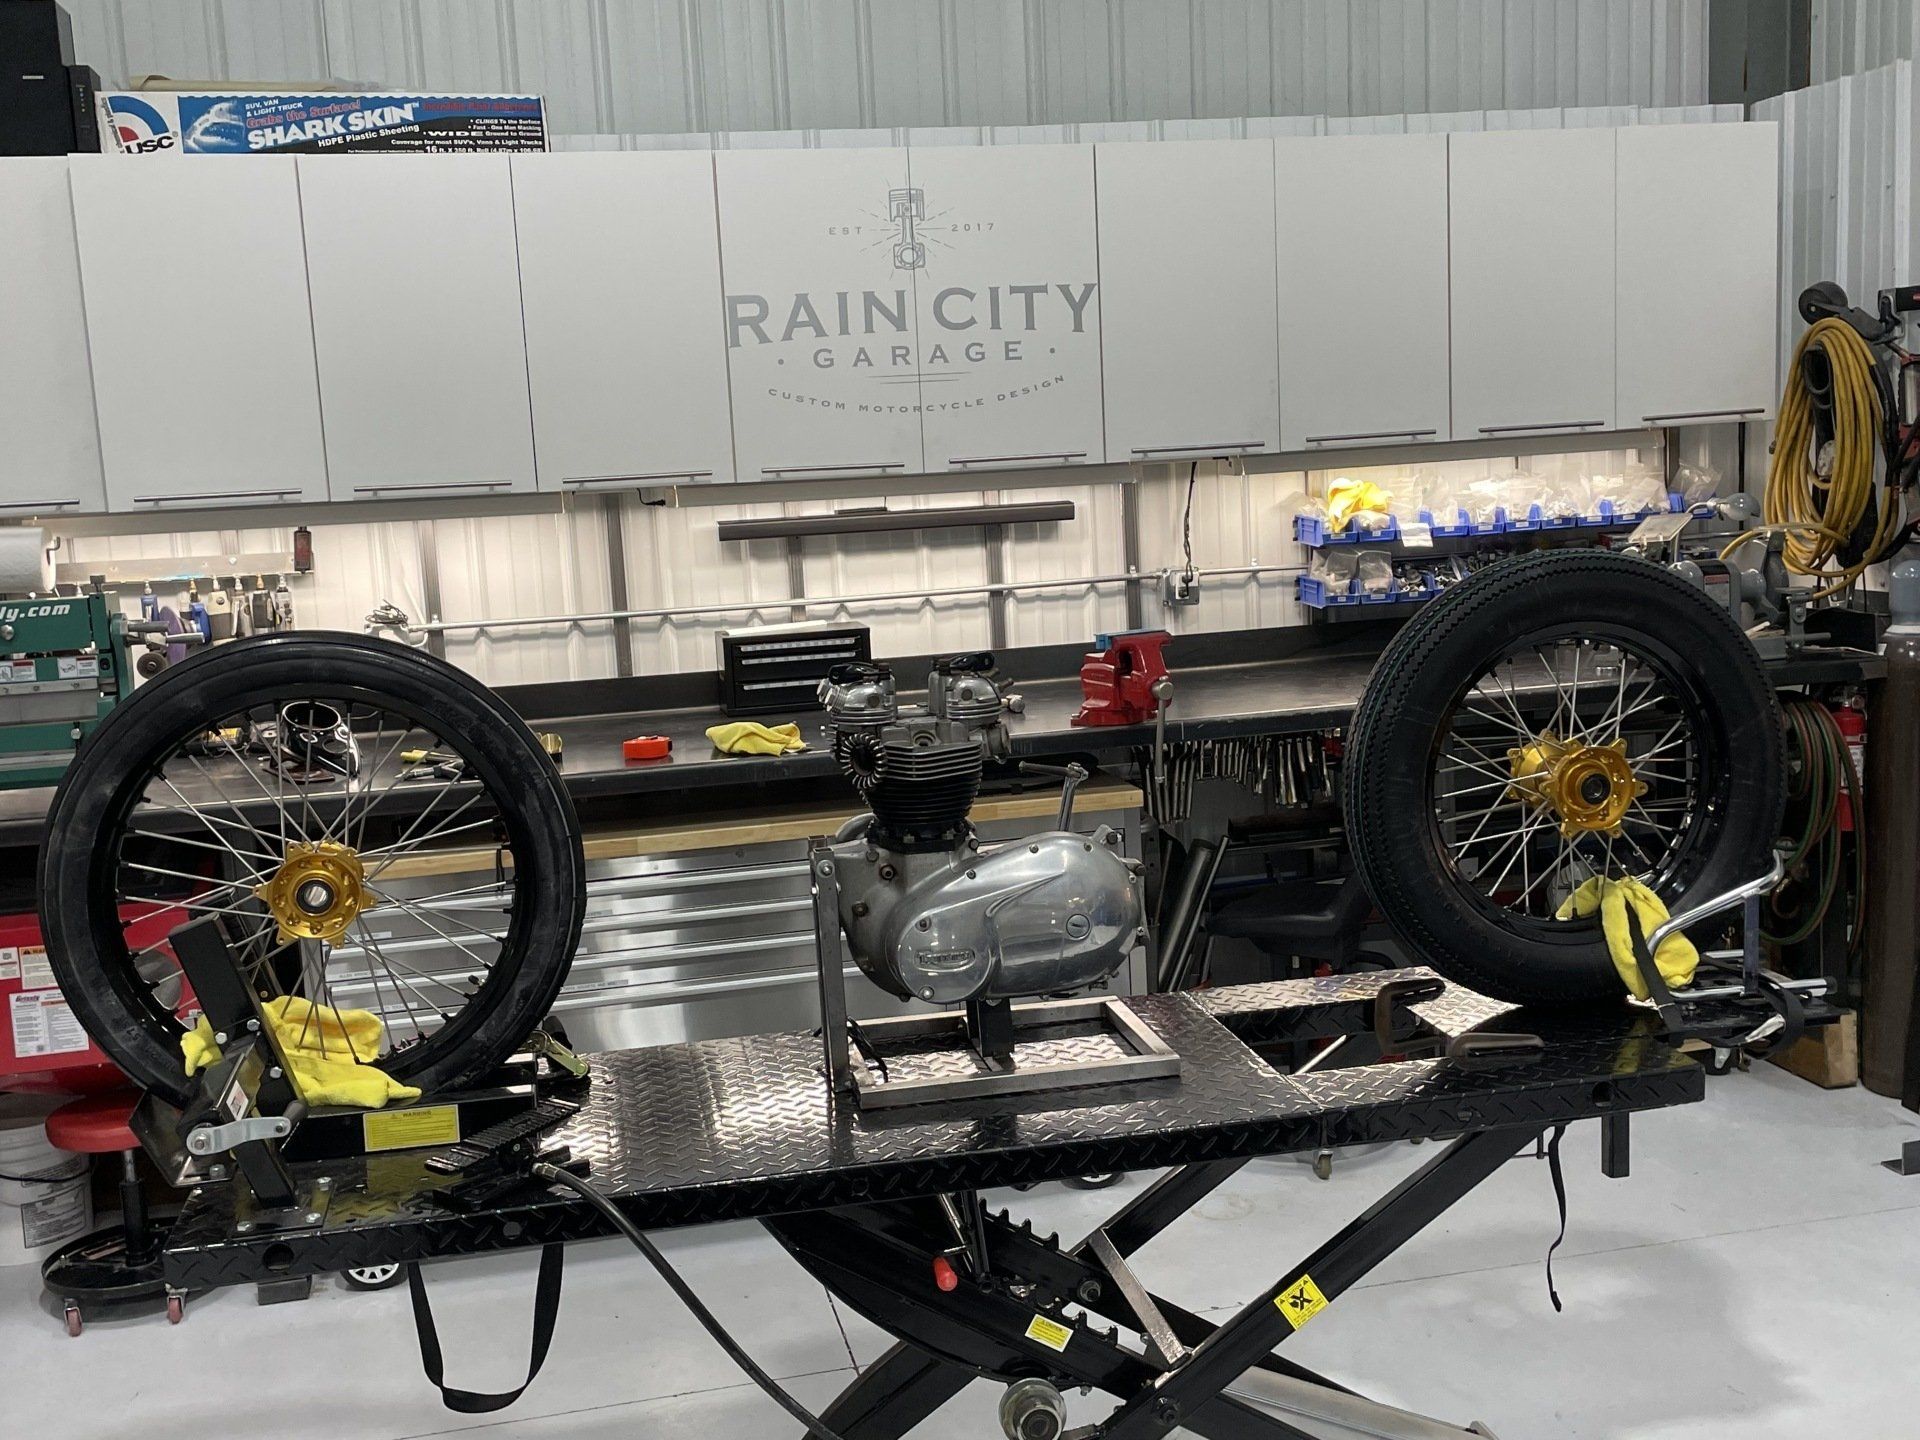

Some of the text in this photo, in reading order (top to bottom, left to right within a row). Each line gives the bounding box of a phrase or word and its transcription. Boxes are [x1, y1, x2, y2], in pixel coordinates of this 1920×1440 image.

[254, 107, 276, 116] LIGHT
[278, 102, 303, 111] TRUCK
[263, 99, 279, 107] VAN
[286, 110, 307, 121] the
[247, 103, 415, 150] SHARK SKIN
[318, 125, 419, 148] HDPE Plastic Sheeting
[125, 136, 174, 154] USC
[828, 222, 995, 235] EST 2017
[726, 282, 1098, 348] RAIN CITY
[813, 340, 1023, 369] GARAGE
[768, 374, 1065, 414] CUSTOM MOTORCYCLE DESIGN
